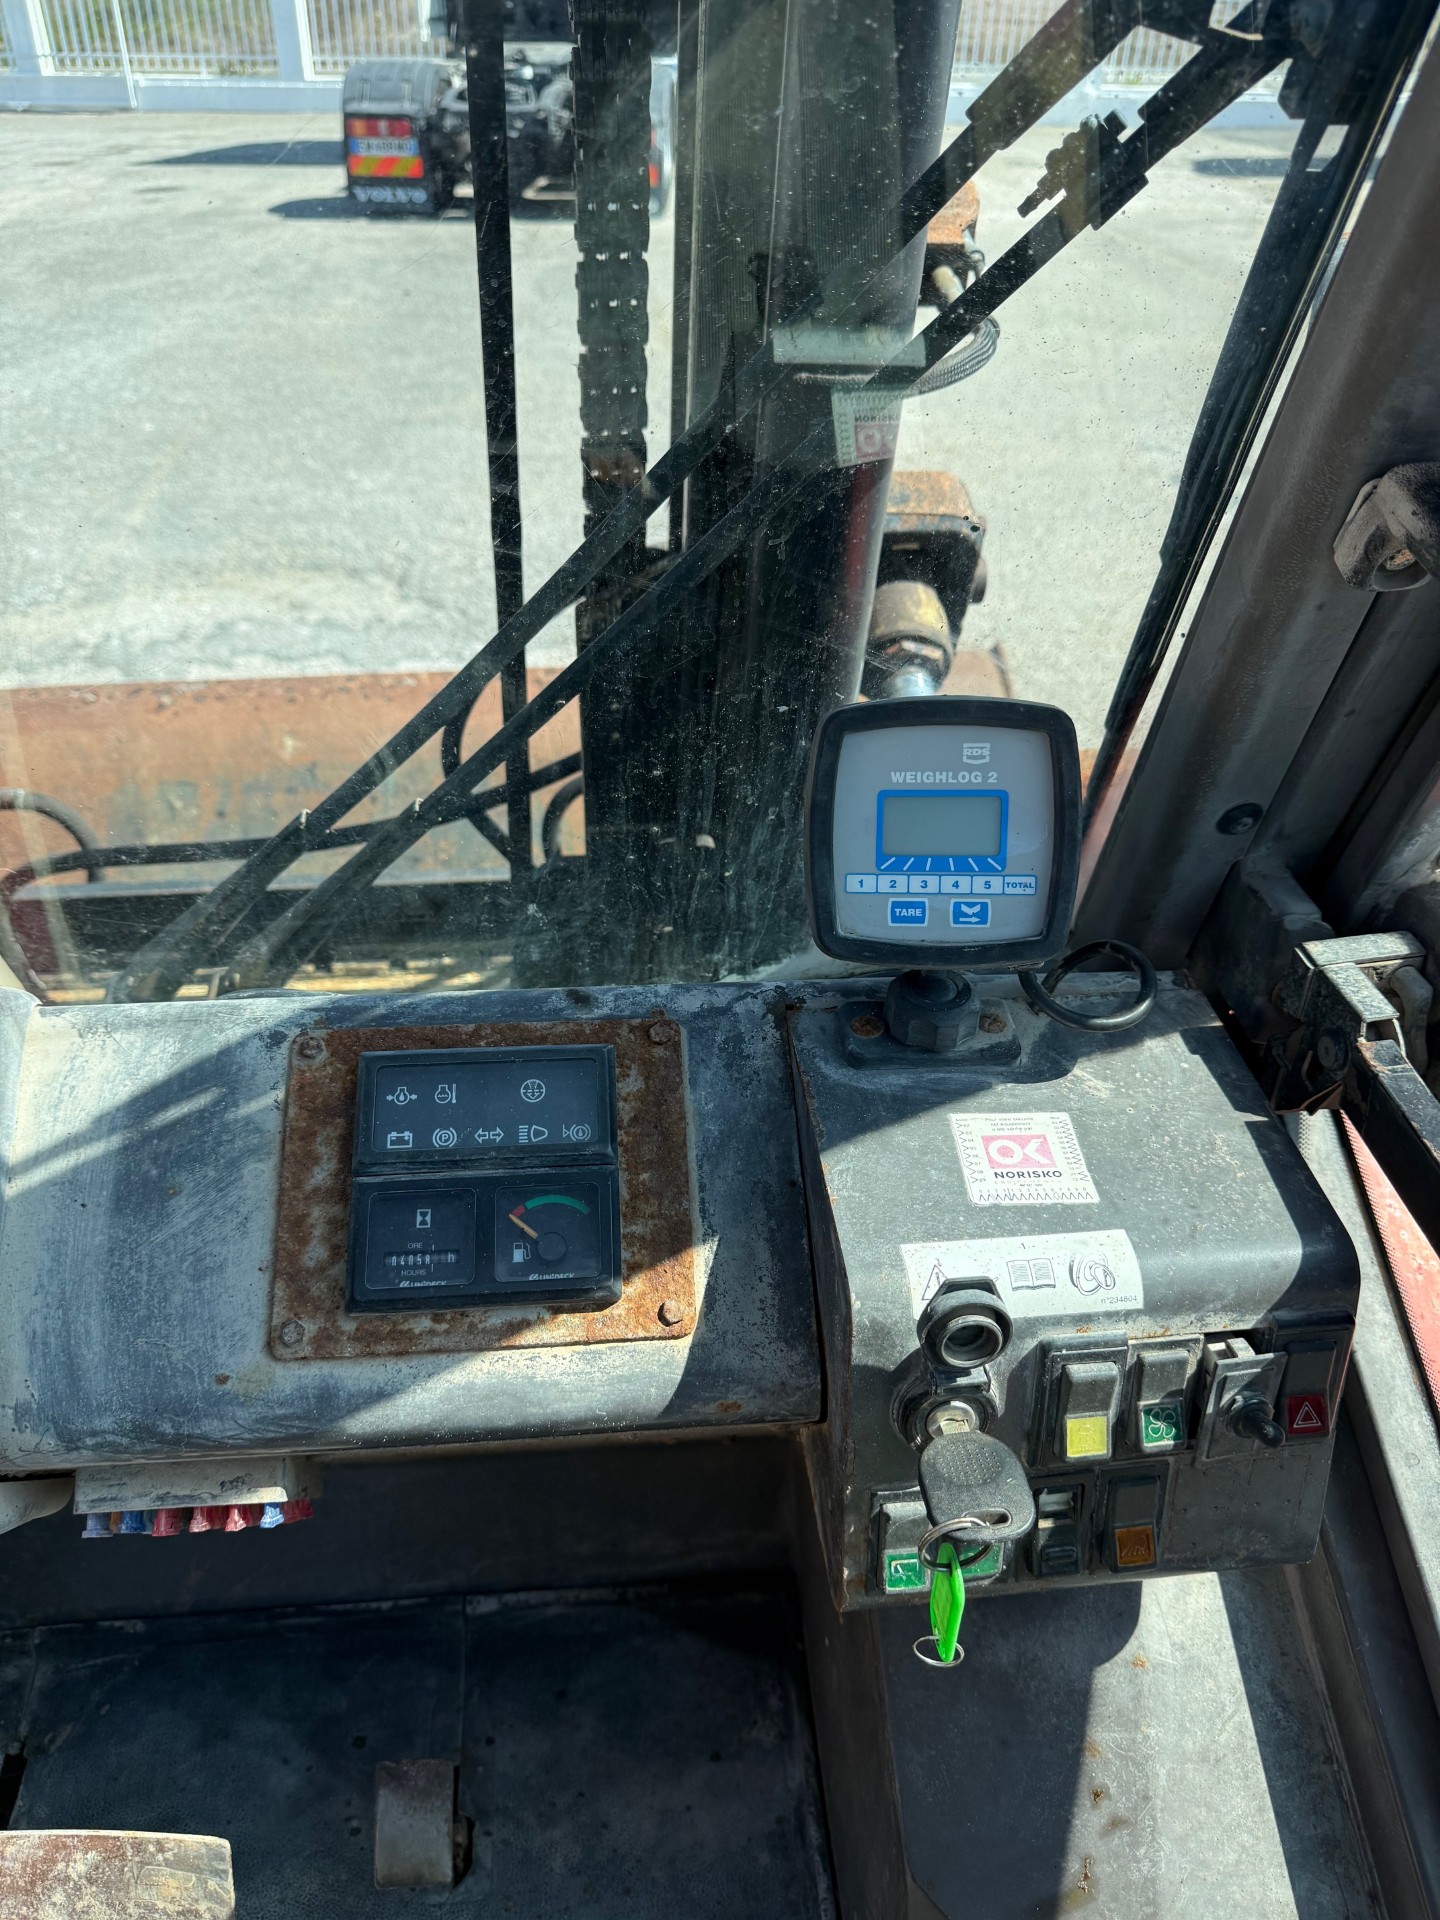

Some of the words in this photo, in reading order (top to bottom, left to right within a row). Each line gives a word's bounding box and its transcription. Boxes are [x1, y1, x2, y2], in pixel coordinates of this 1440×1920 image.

[353, 186, 427, 204] VOLVO
[963, 747, 990, 757] RDS
[890, 771, 983, 784] WEIGHLOG
[987, 771, 998, 784] 2
[857, 879, 864, 889] 1
[889, 879, 897, 889] 2
[920, 879, 928, 889] 3
[951, 880, 960, 889] 4
[983, 880, 991, 890] 5
[1005, 881, 1035, 890] TOTAL
[894, 907, 923, 917] TARE
[988, 1138, 1053, 1165] OK
[994, 1170, 1062, 1179] NORISKO
[447, 1251, 455, 1263] h
[401, 1268, 427, 1276] HOURS
[1101, 1295, 1137, 1304] n°234804
